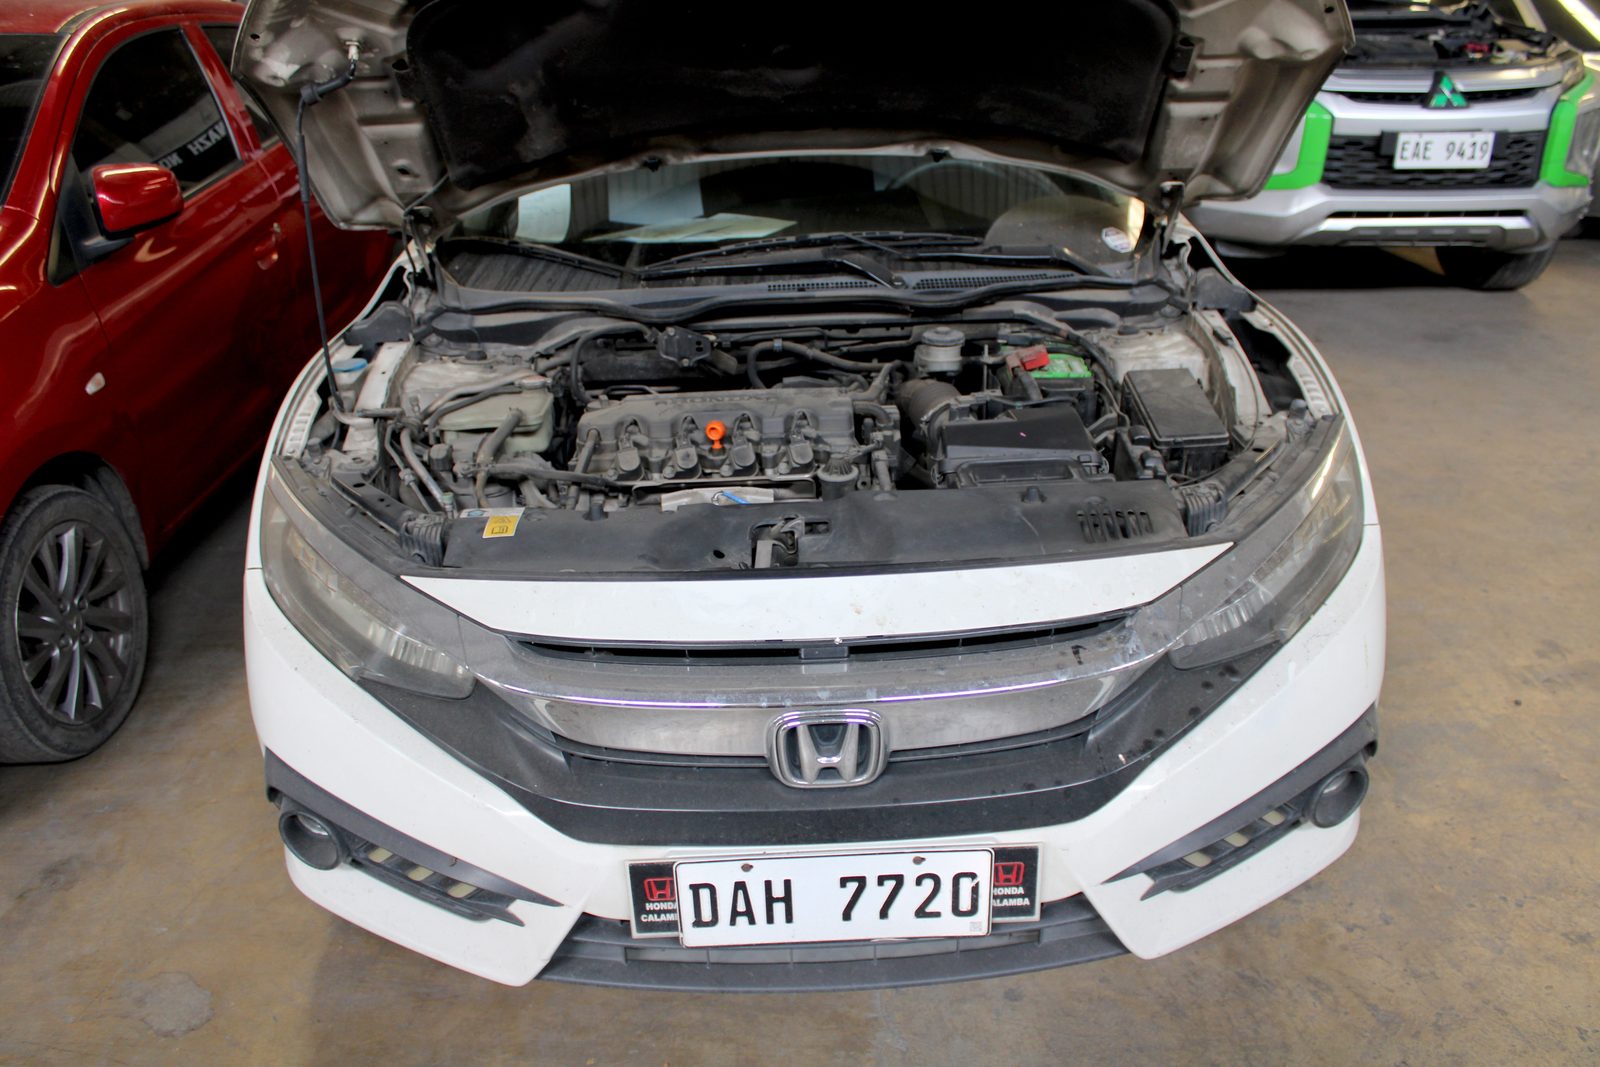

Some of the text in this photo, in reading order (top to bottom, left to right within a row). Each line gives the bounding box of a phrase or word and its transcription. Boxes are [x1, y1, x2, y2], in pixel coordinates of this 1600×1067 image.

[1400, 141, 1489, 160] EAE 9419
[689, 872, 980, 928] DAH 7720
